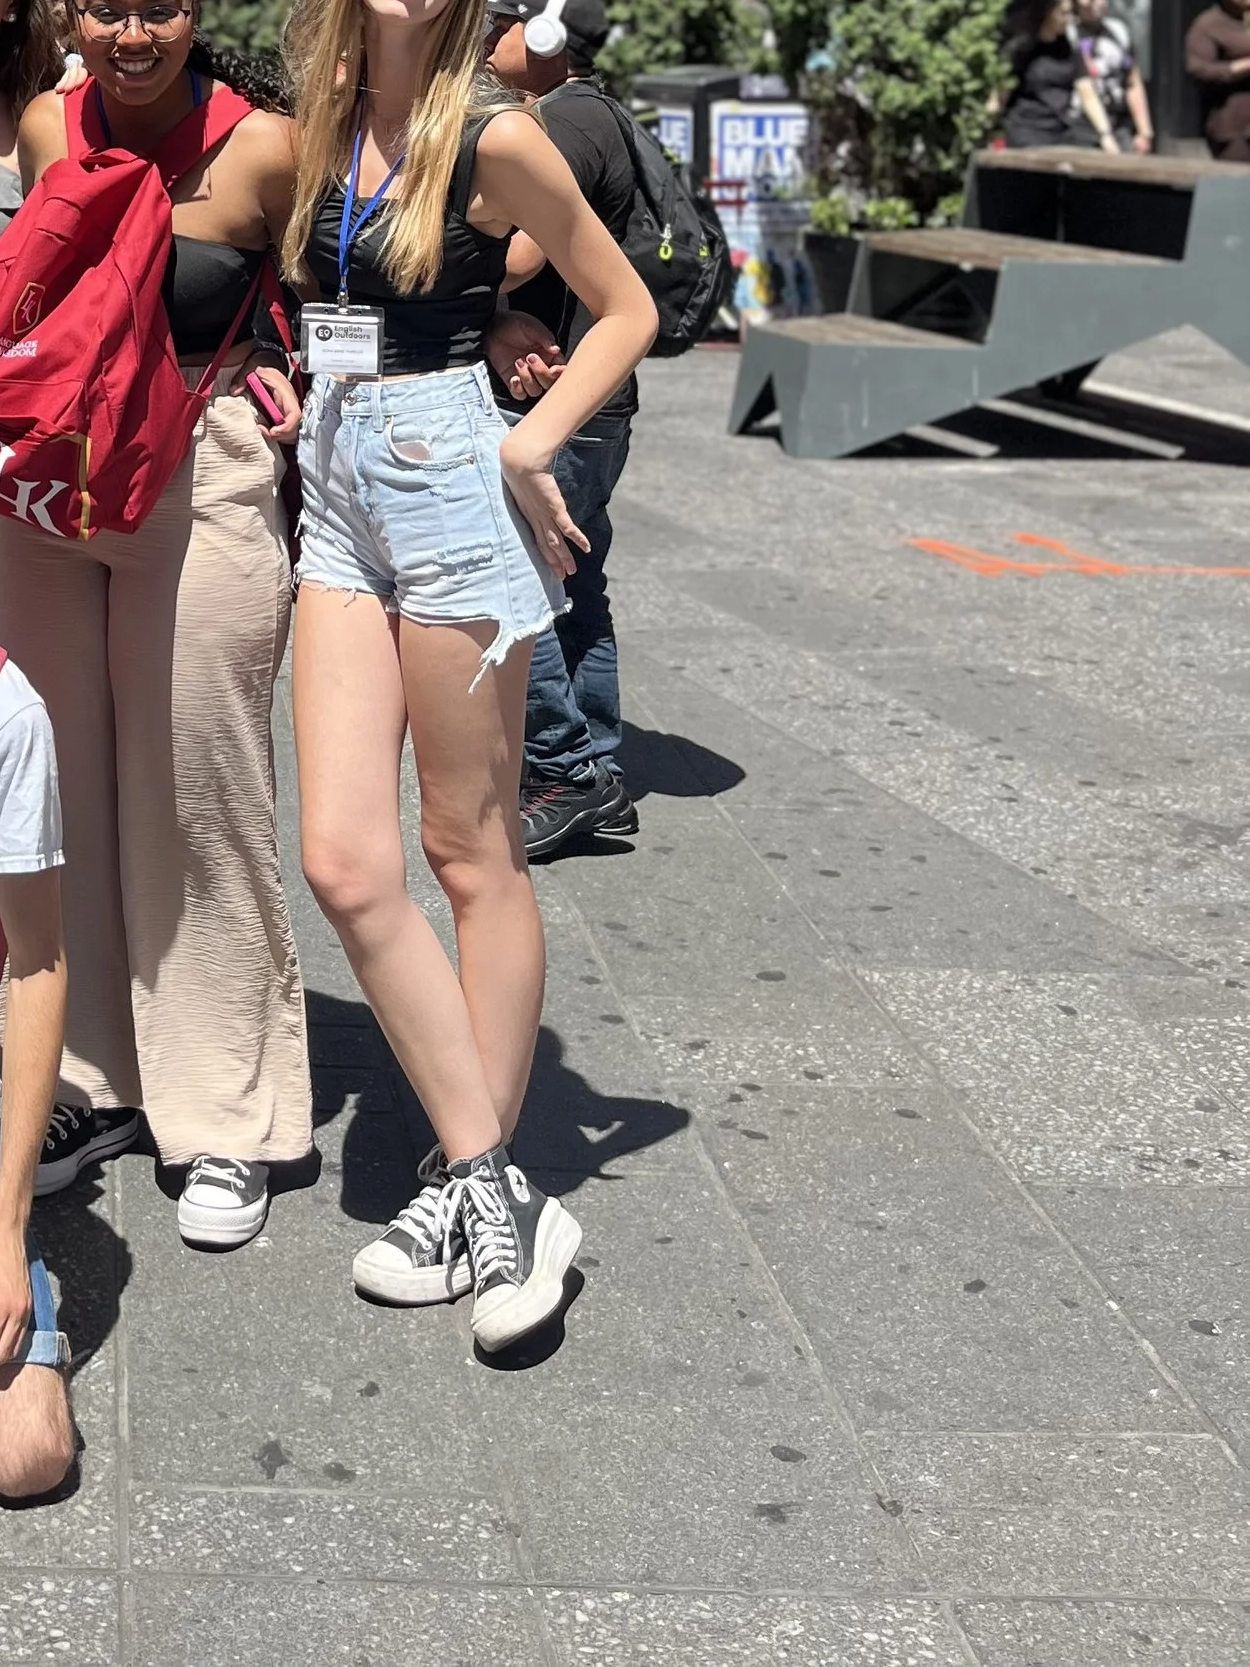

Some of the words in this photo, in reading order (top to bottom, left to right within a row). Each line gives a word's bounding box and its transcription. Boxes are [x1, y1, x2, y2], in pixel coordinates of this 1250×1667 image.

[723, 117, 810, 147] BLUE
[334, 325, 363, 333] English
[334, 332, 371, 340] Outdoors
